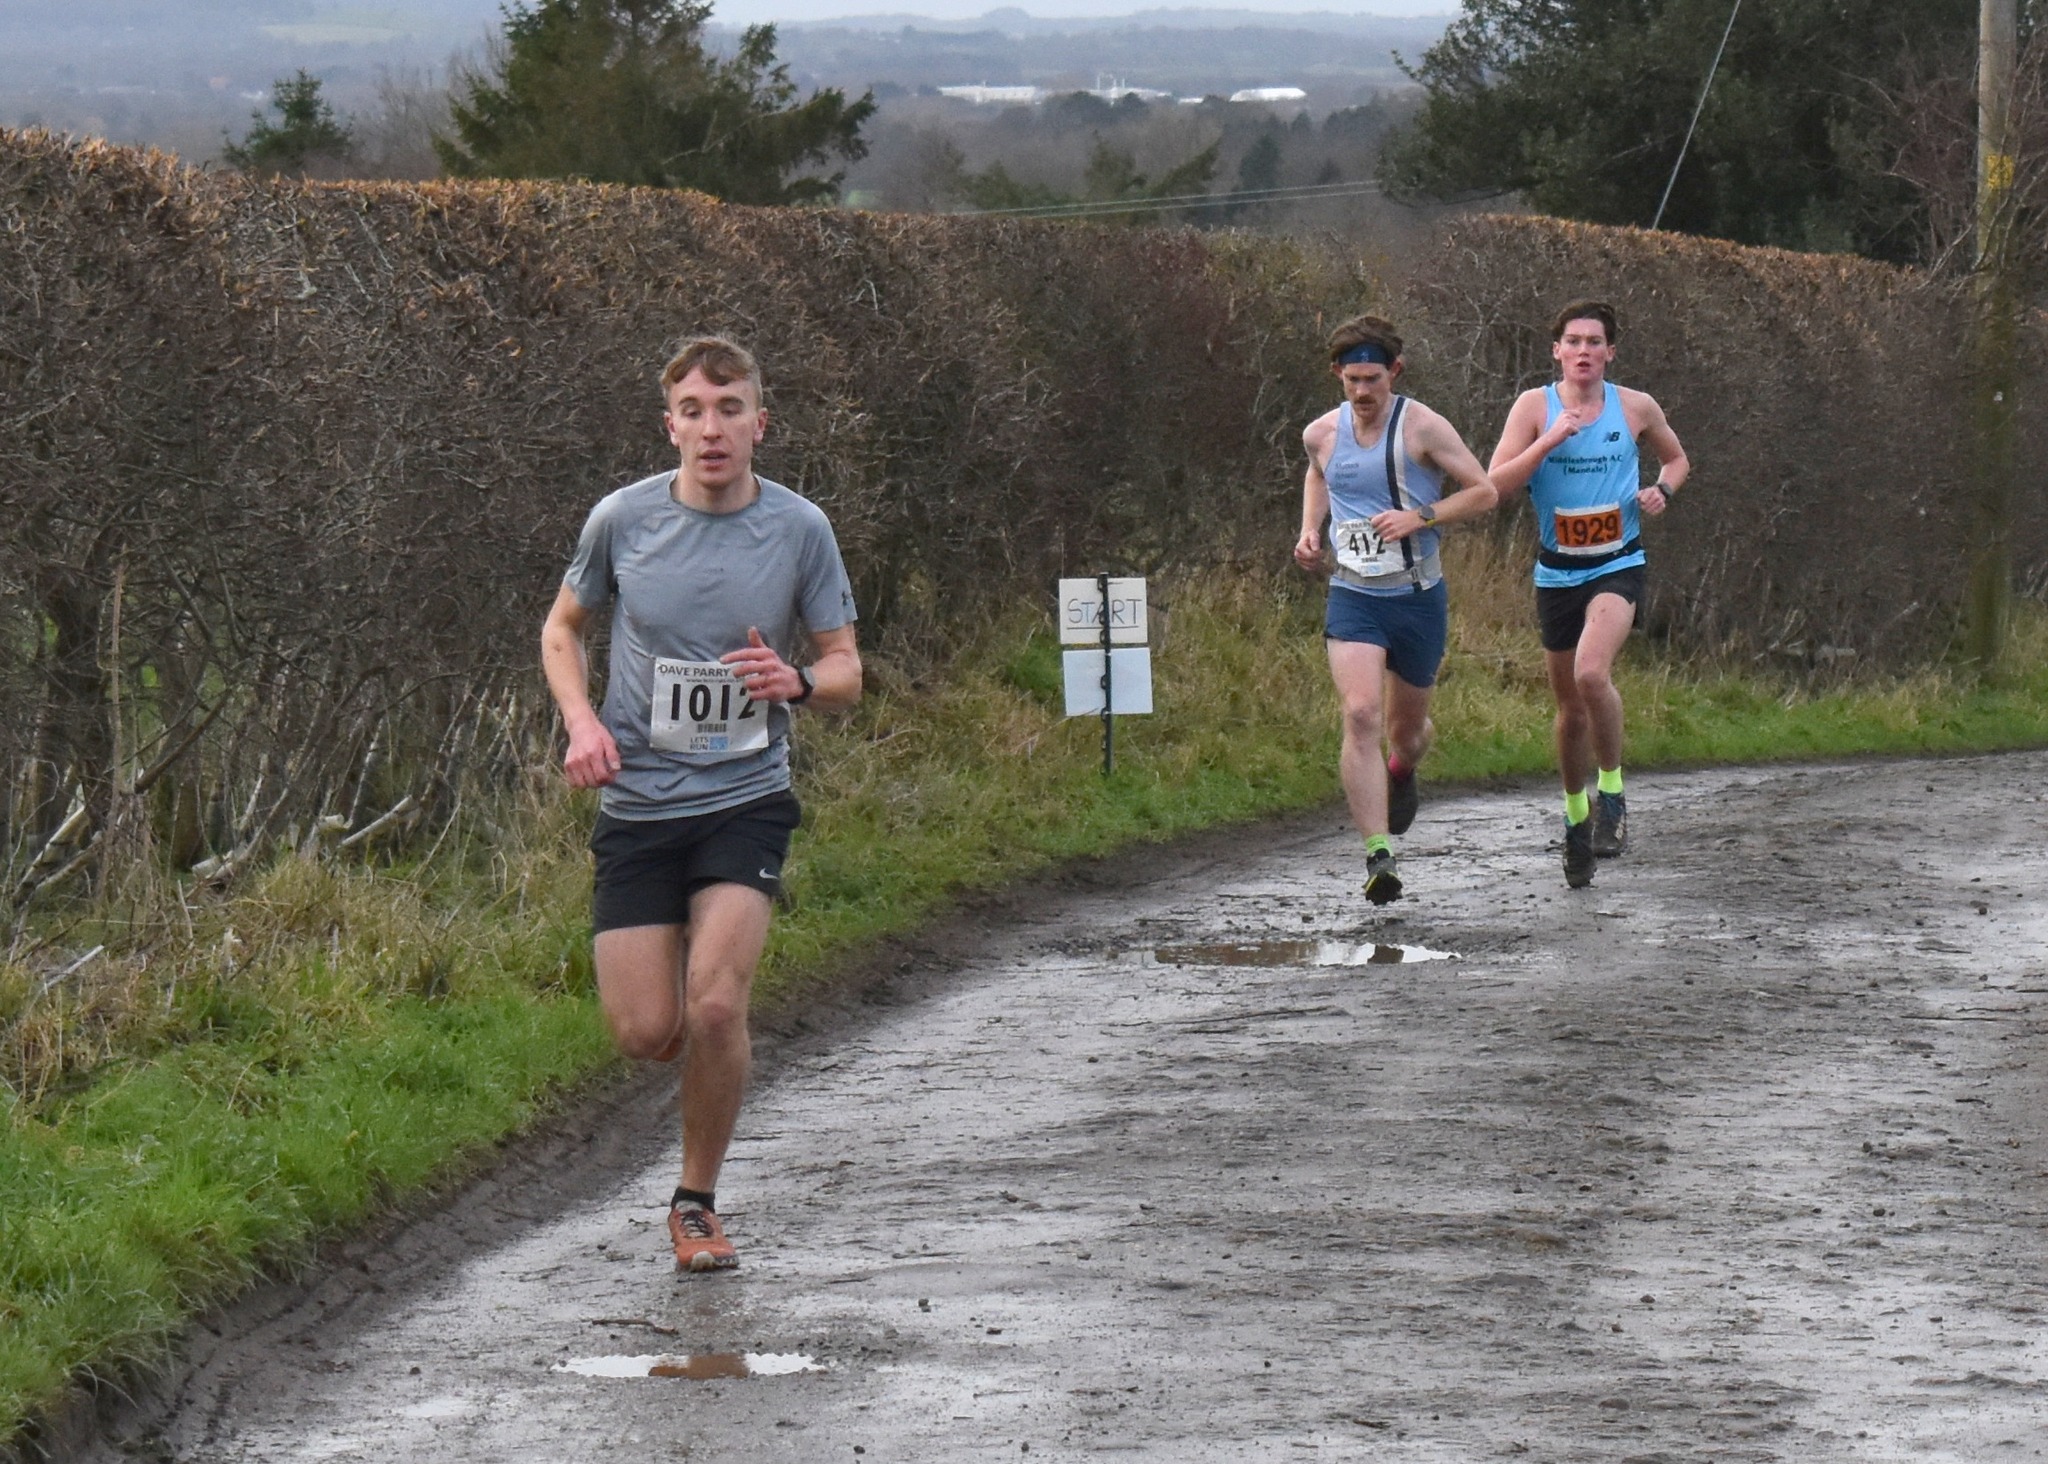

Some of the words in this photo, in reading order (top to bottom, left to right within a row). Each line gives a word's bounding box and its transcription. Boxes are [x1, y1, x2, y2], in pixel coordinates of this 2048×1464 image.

[1559, 514, 1618, 544] 1929
[1349, 533, 1385, 556] 412
[659, 664, 690, 676] DAVE
[693, 668, 730, 677] PARRY
[671, 684, 755, 721] 1012
